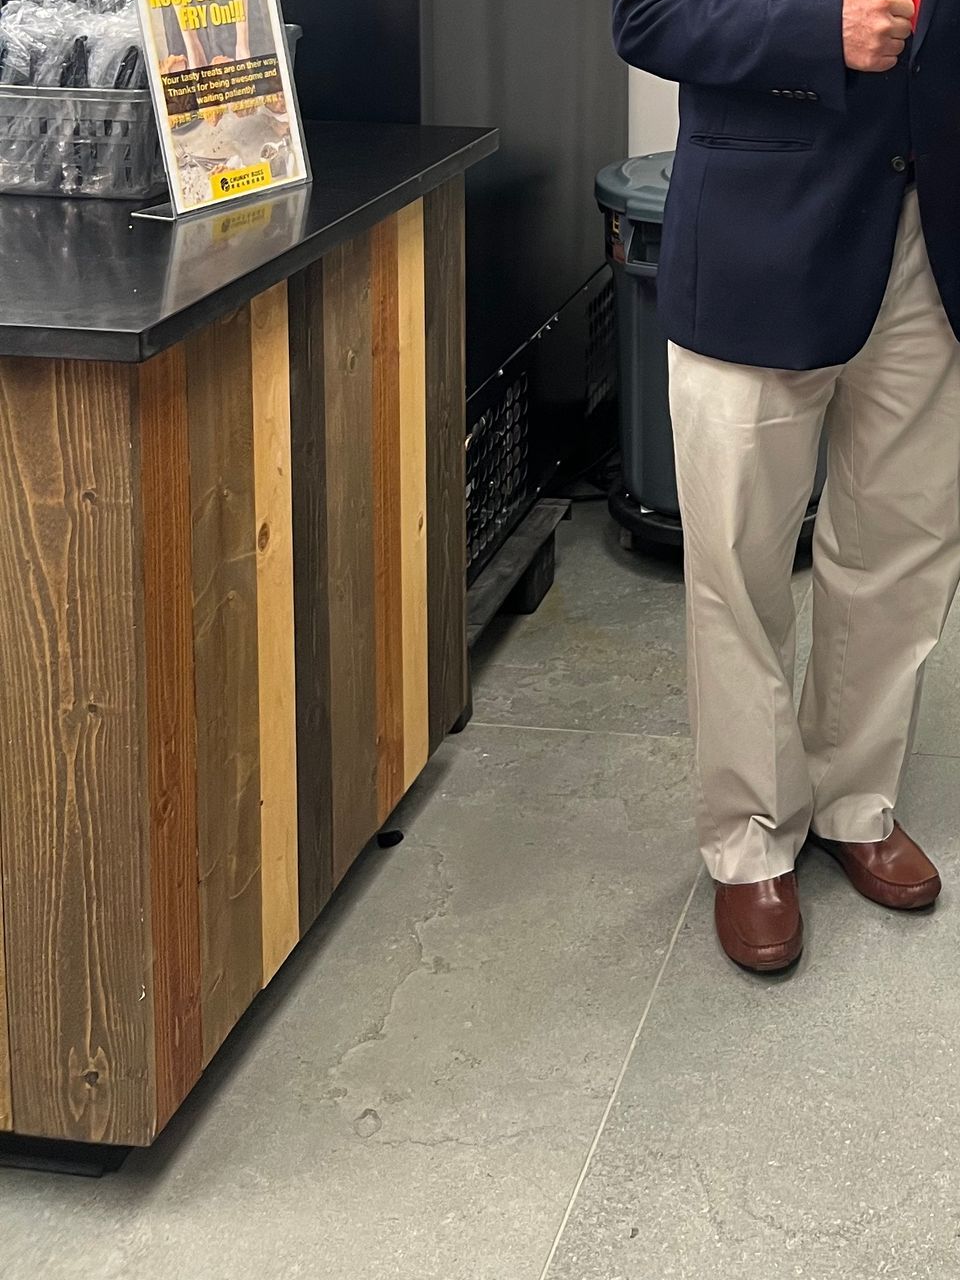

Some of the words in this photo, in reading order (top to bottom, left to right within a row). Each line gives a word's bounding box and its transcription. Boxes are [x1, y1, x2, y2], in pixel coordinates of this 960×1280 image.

[179, 5, 208, 31] FRY
[209, 0, 246, 26] On!!!
[161, 75, 180, 86] Your
[181, 72, 200, 83] tasty
[201, 68, 223, 79] treats
[223, 65, 235, 73] are
[246, 59, 262, 69] their
[262, 57, 279, 66] way.
[167, 85, 196, 97] Thanks
[196, 82, 208, 92] for
[208, 78, 230, 89] being
[230, 73, 263, 85] awesome
[263, 68, 278, 77] and
[196, 91, 224, 104] waiting
[224, 84, 257, 100] patiently!
